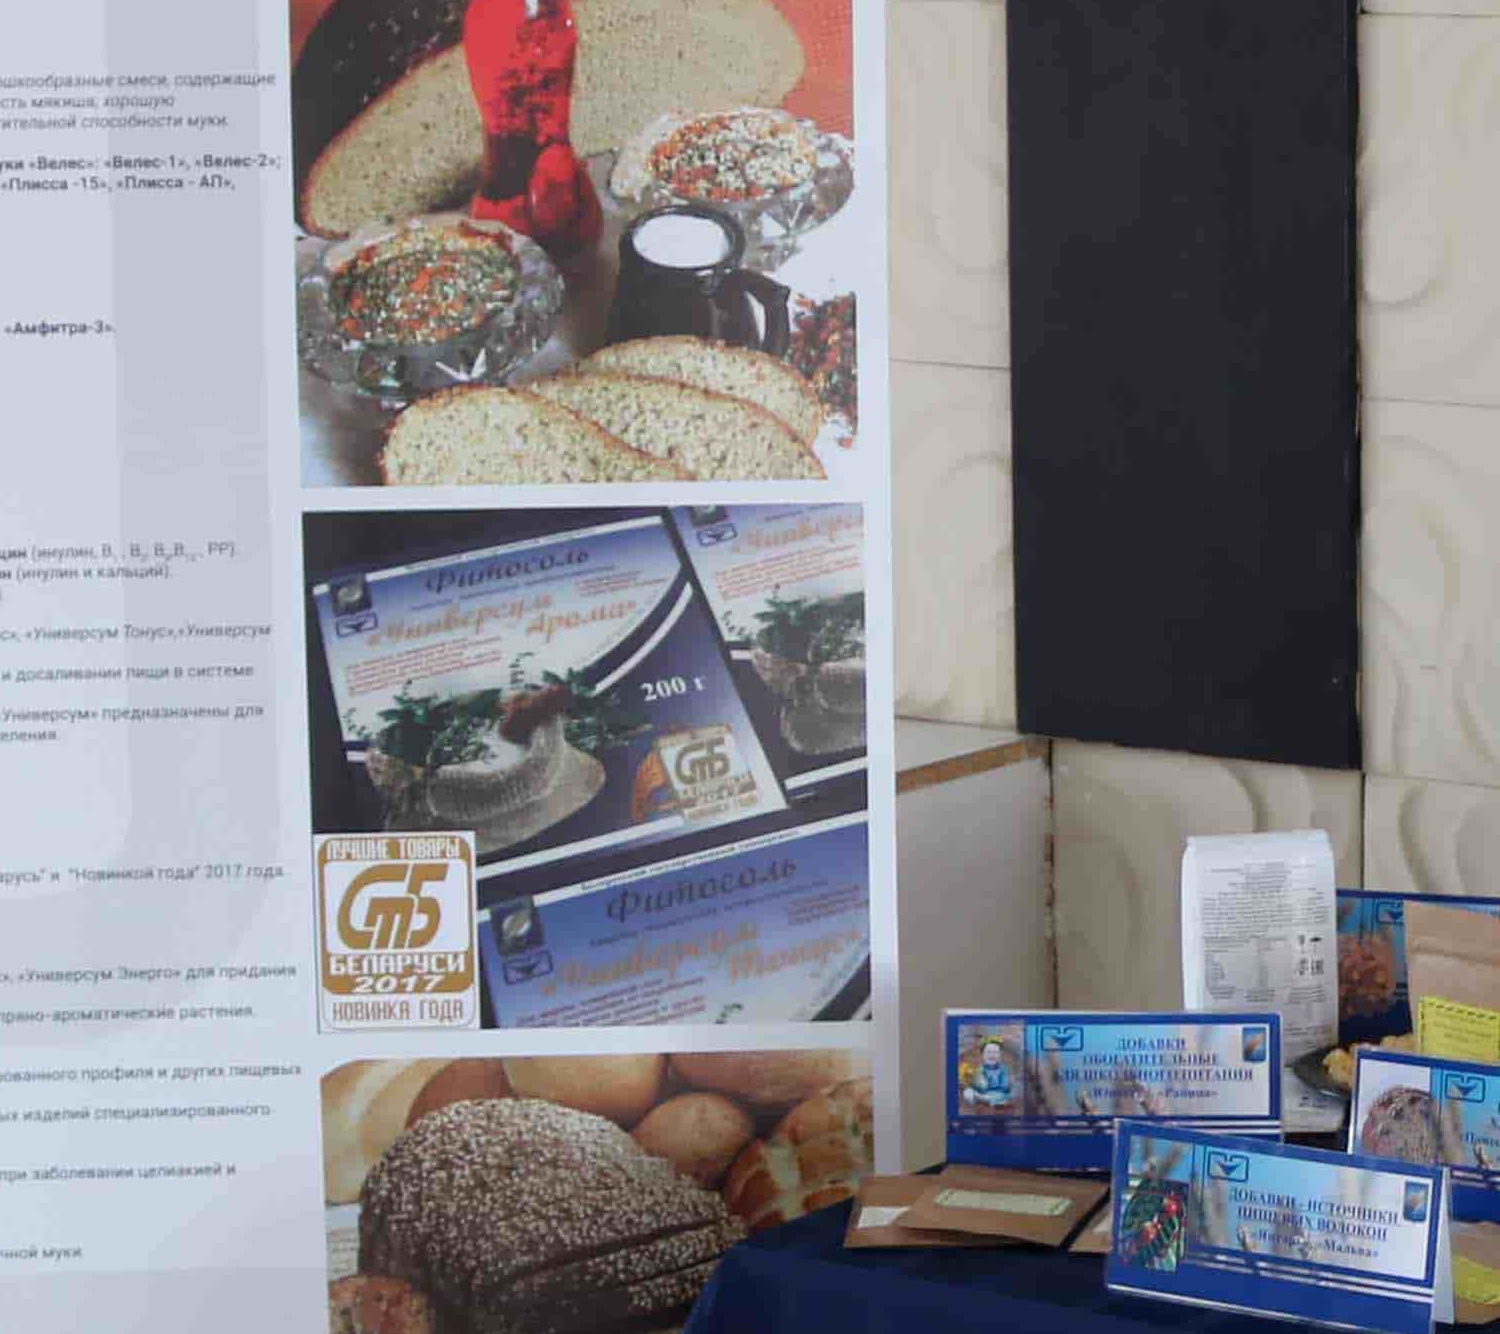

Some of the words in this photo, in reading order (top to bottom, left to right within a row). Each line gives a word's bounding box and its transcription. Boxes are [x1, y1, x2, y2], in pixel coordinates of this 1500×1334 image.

[640, 675, 687, 702] 200
[330, 954, 466, 975] БЕЛАРУСИ
[352, 973, 445, 993] 2017
[333, 1000, 409, 1020] НОВИНКА
[420, 1000, 464, 1024] ГОДА
